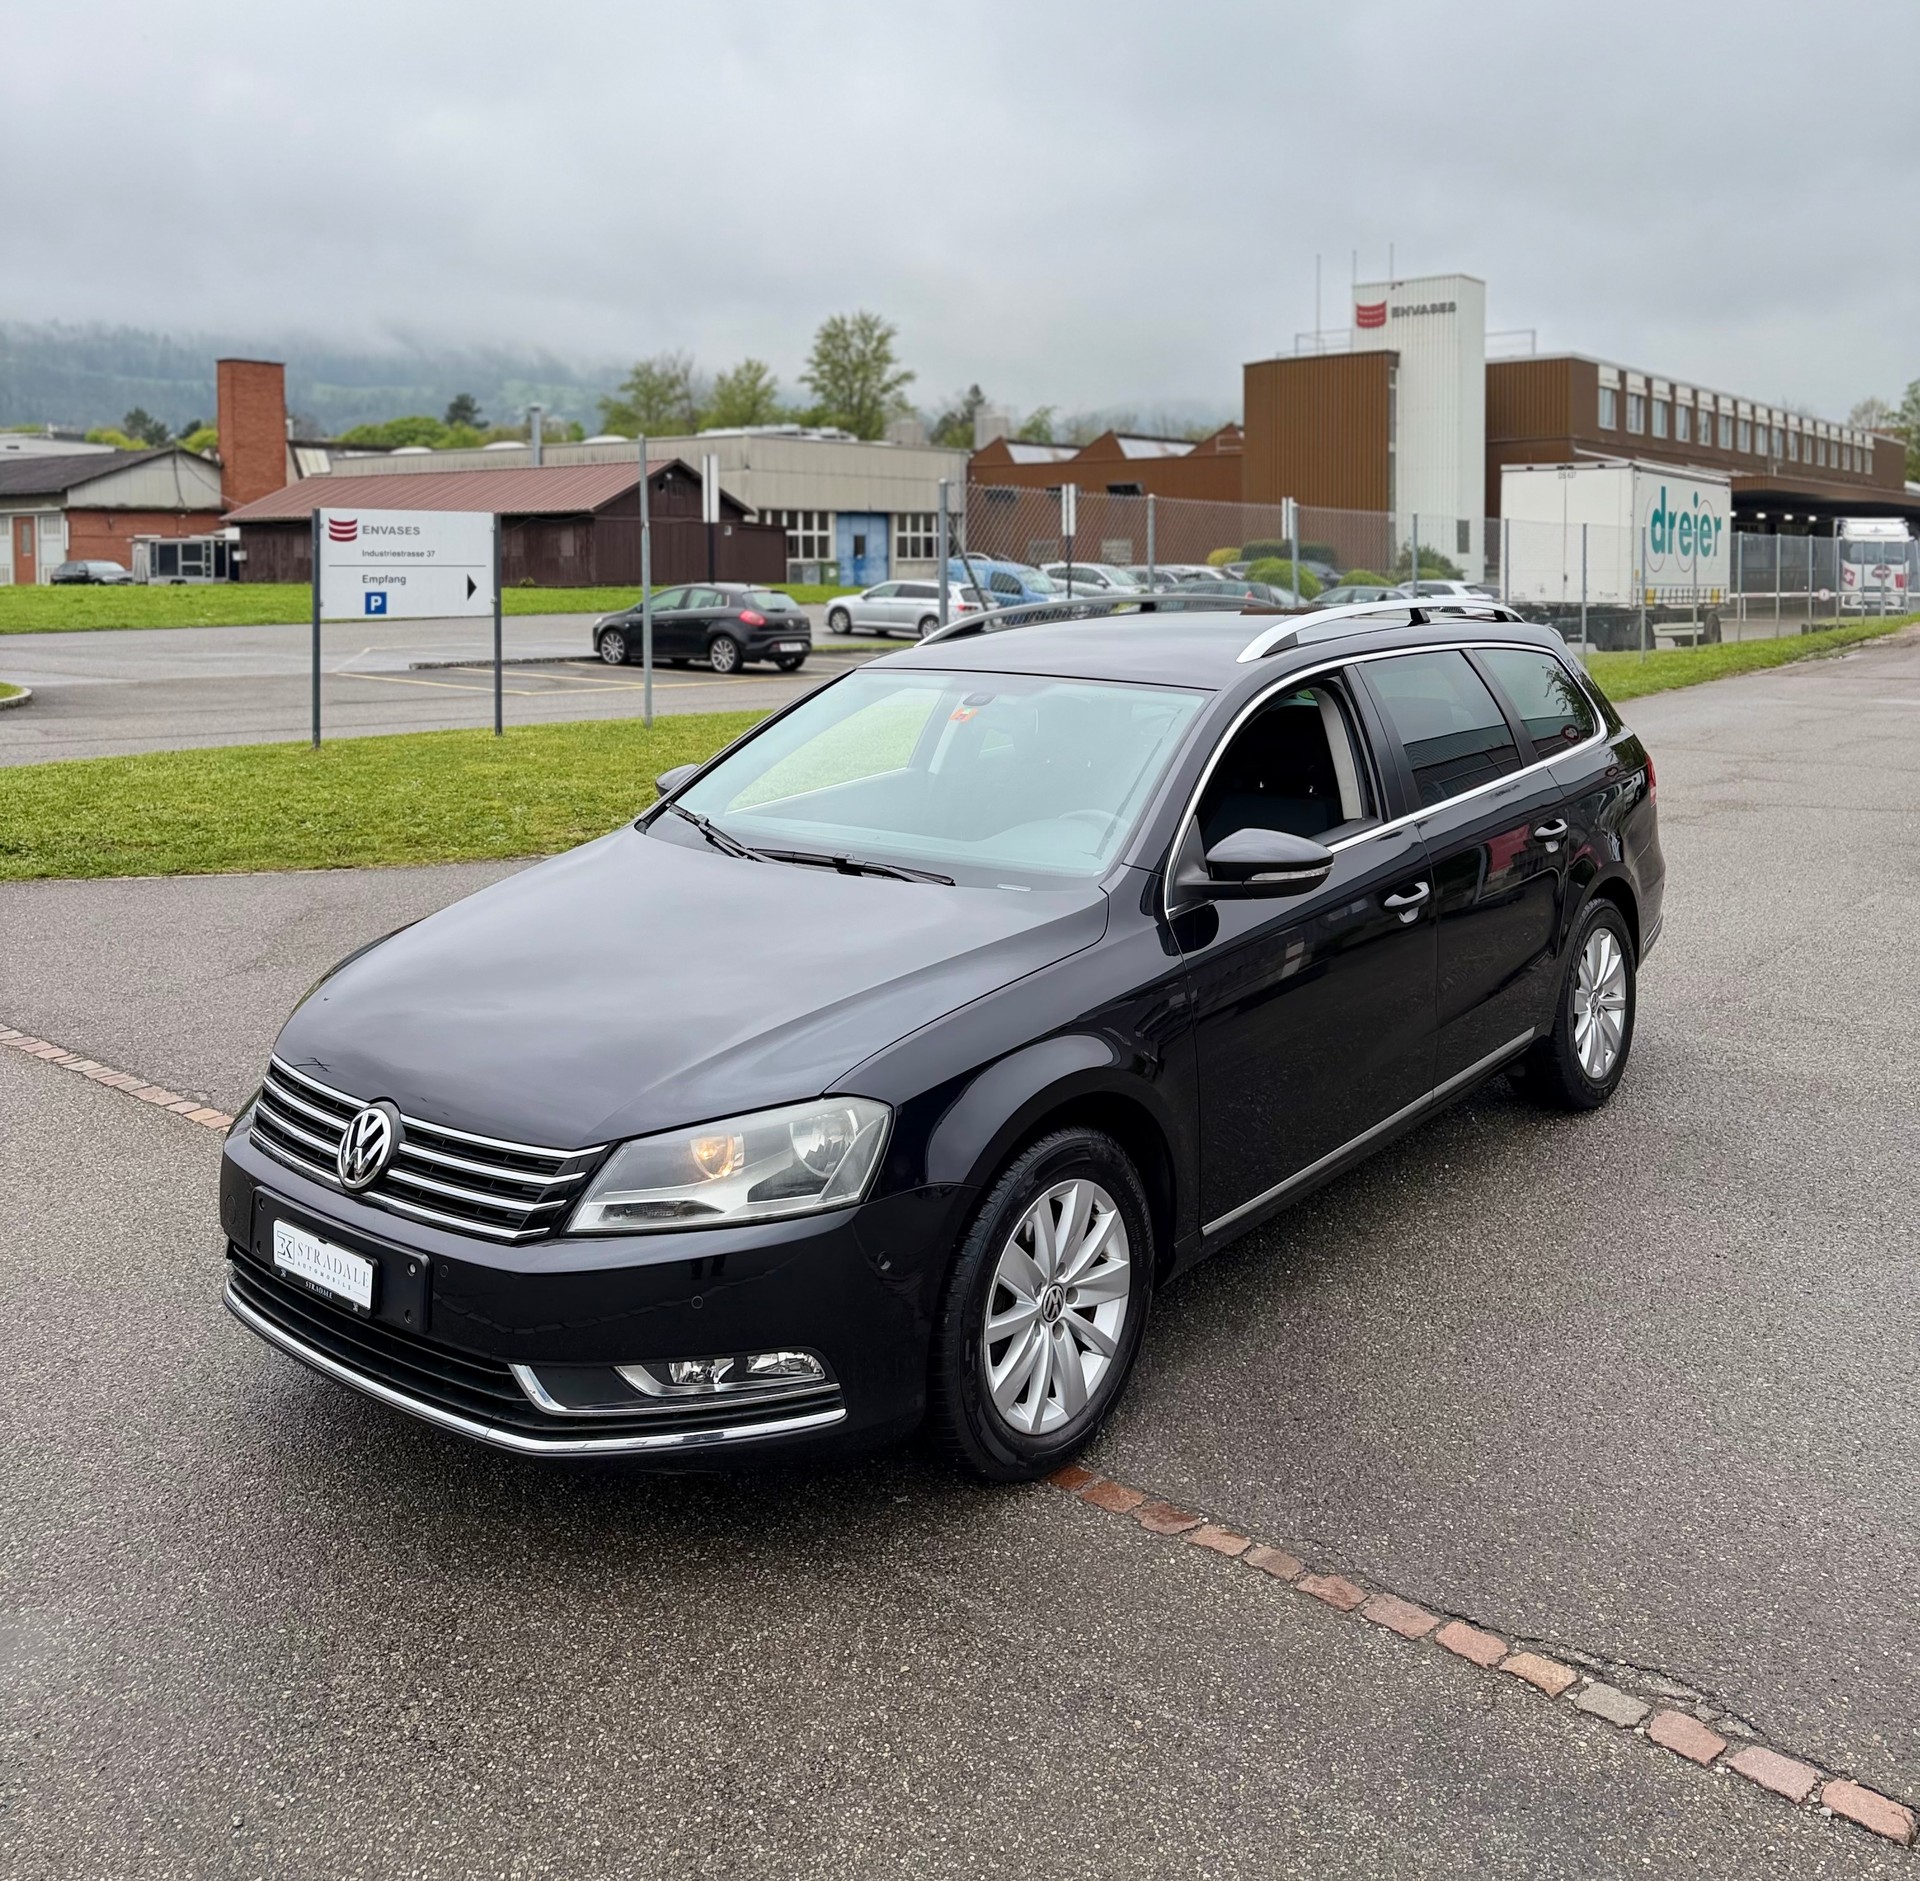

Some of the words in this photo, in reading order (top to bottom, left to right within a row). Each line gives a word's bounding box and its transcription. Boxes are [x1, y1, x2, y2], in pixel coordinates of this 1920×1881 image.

[1391, 302, 1456, 318] ENVASES
[1651, 486, 1722, 557] dreier
[362, 525, 421, 536] ENVASES
[362, 549, 425, 558] Industriestrasse
[362, 574, 407, 586] Empfang
[297, 1242, 369, 1288] STRADALE
[305, 1280, 333, 1300] STRADALE
